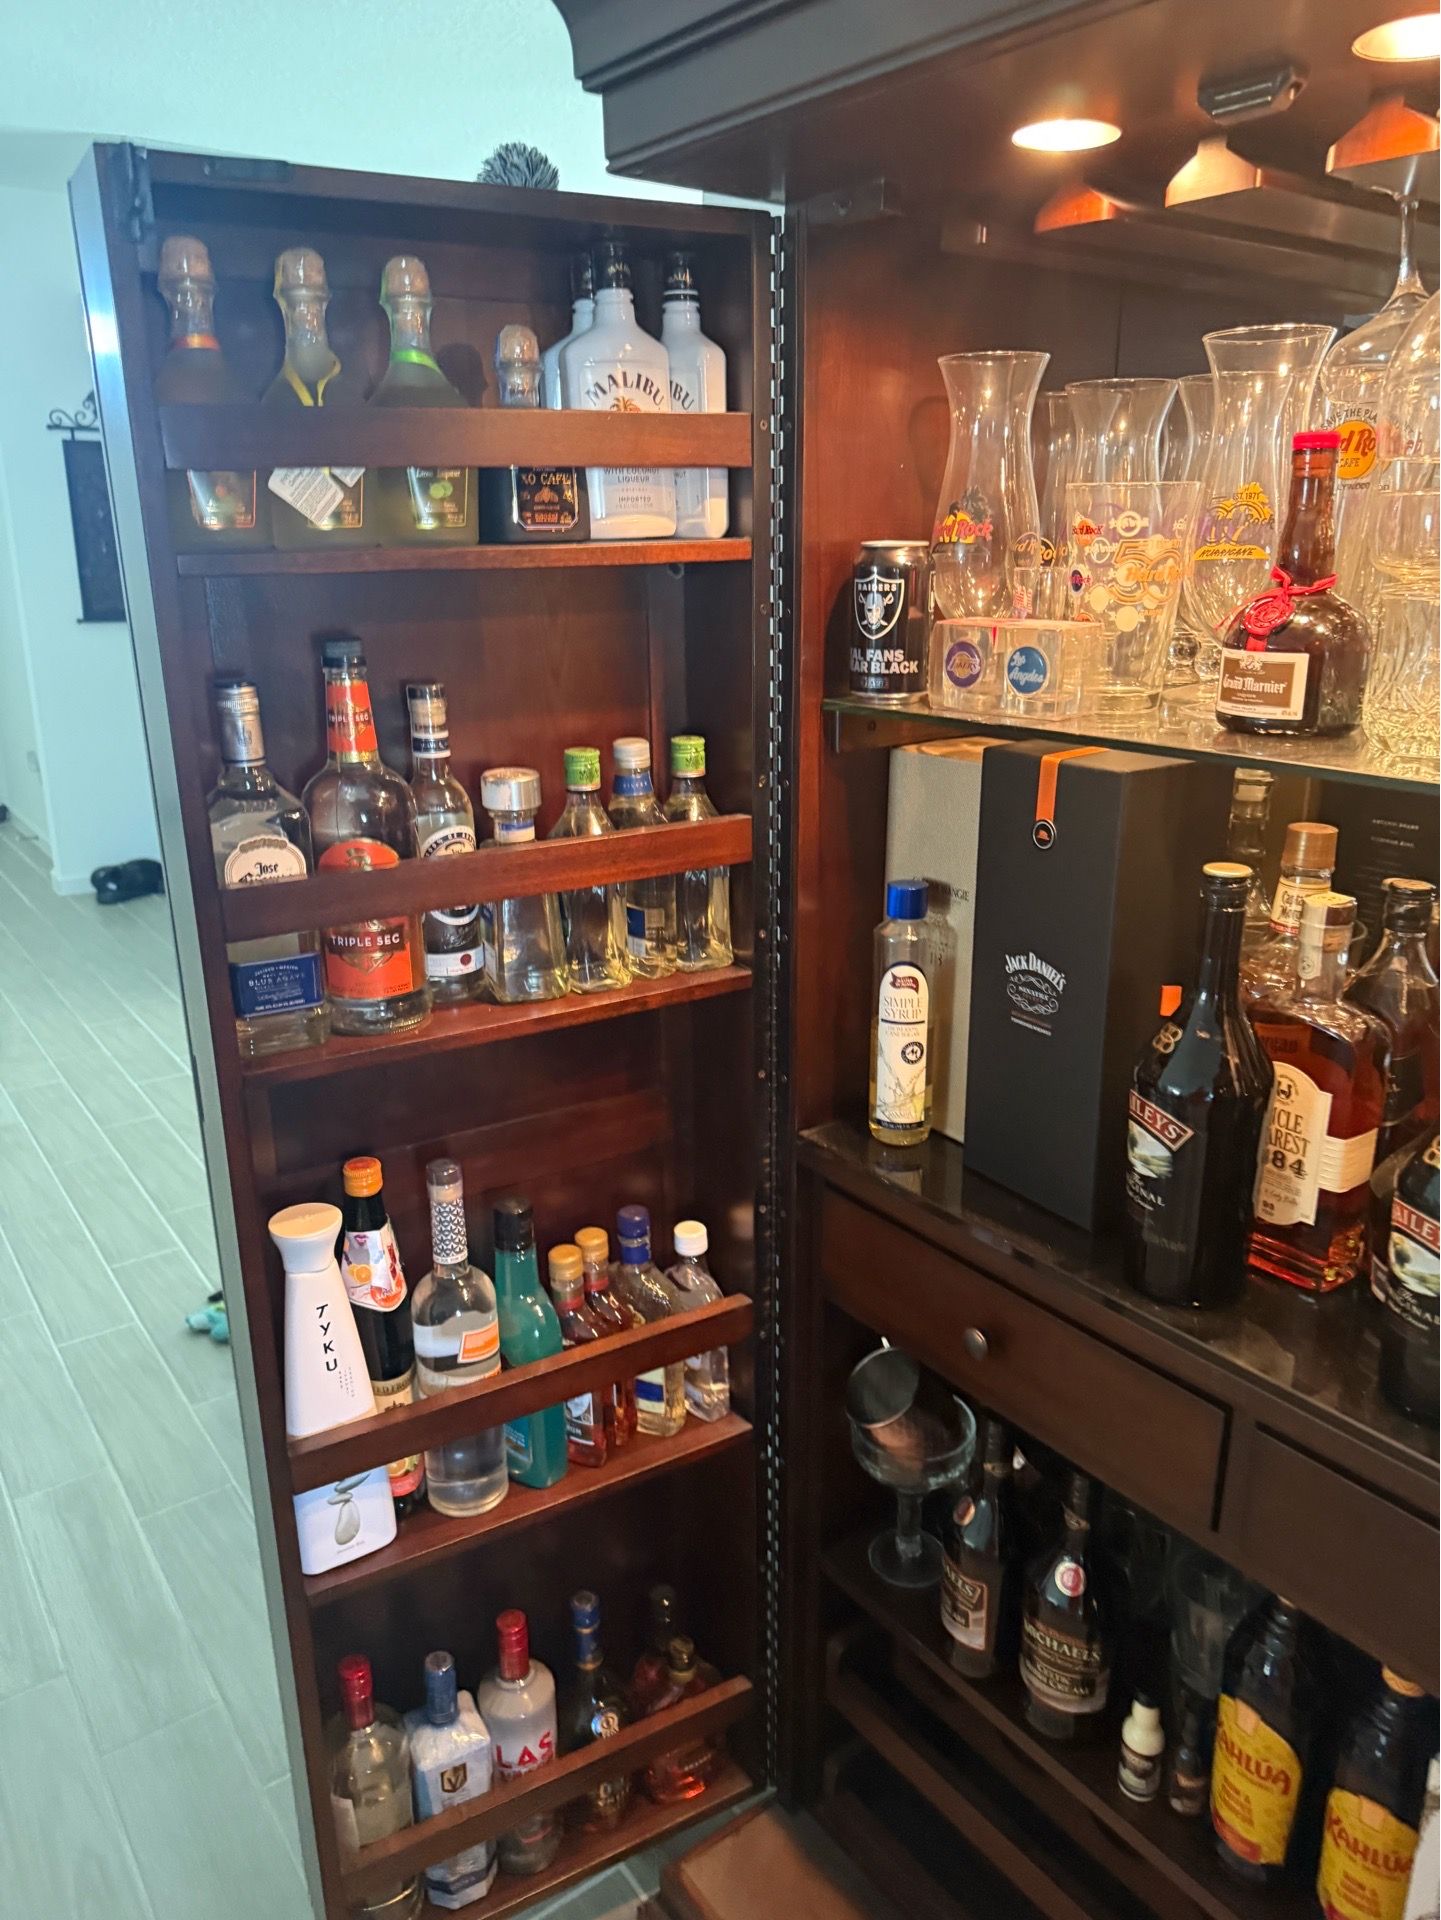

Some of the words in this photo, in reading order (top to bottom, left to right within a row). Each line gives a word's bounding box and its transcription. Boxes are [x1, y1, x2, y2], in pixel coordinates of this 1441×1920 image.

[584, 370, 665, 406] MALIBU
[670, 379, 695, 411] IBU
[1344, 407, 1362, 418] THE
[1363, 408, 1378, 425] PLA
[617, 475, 650, 484] LIQUEUR
[857, 583, 897, 592] RAIDERS
[866, 648, 905, 662] FANS
[870, 660, 919, 675] BLACK
[1243, 677, 1287, 694] Marnier
[254, 862, 279, 877] Jose
[330, 934, 373, 947] TRIPLE
[376, 932, 401, 947] SEC
[1005, 953, 1028, 974] JACK
[1028, 951, 1067, 995] DANIEL'S
[883, 995, 921, 1009] SIMPLE
[884, 1007, 922, 1020] SYRUP
[315, 1303, 338, 1372] TYKU
[495, 1729, 554, 1769] LAS
[1216, 1720, 1291, 1797] AHLÚA
